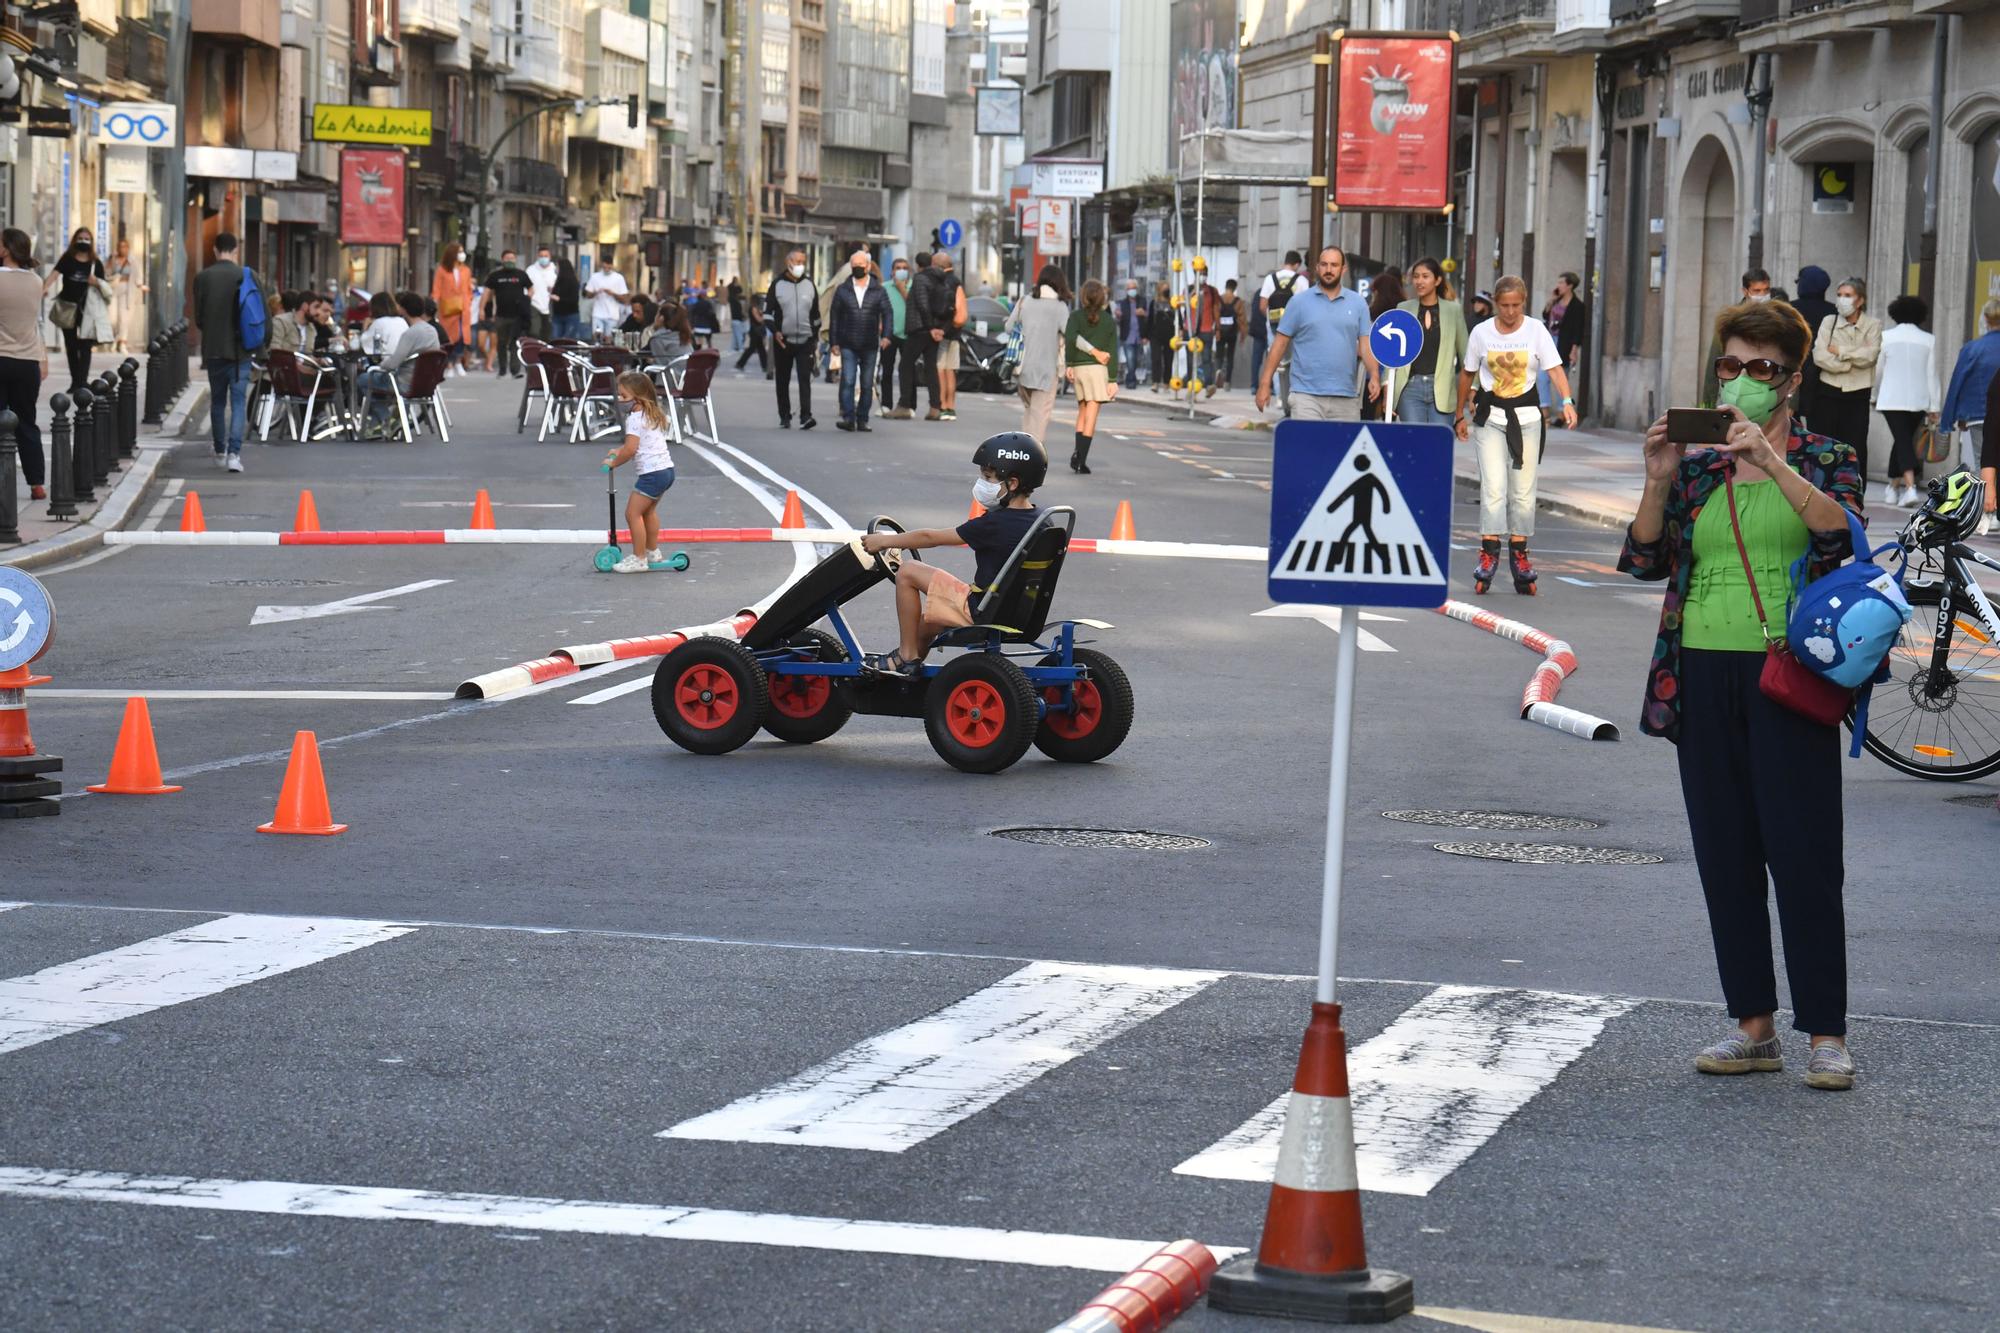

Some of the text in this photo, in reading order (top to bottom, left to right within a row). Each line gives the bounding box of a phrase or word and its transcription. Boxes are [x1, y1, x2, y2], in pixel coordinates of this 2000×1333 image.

[316, 112, 431, 137] La Academia
[997, 448, 1031, 461] Pablo
[1936, 597, 1951, 639] 092
